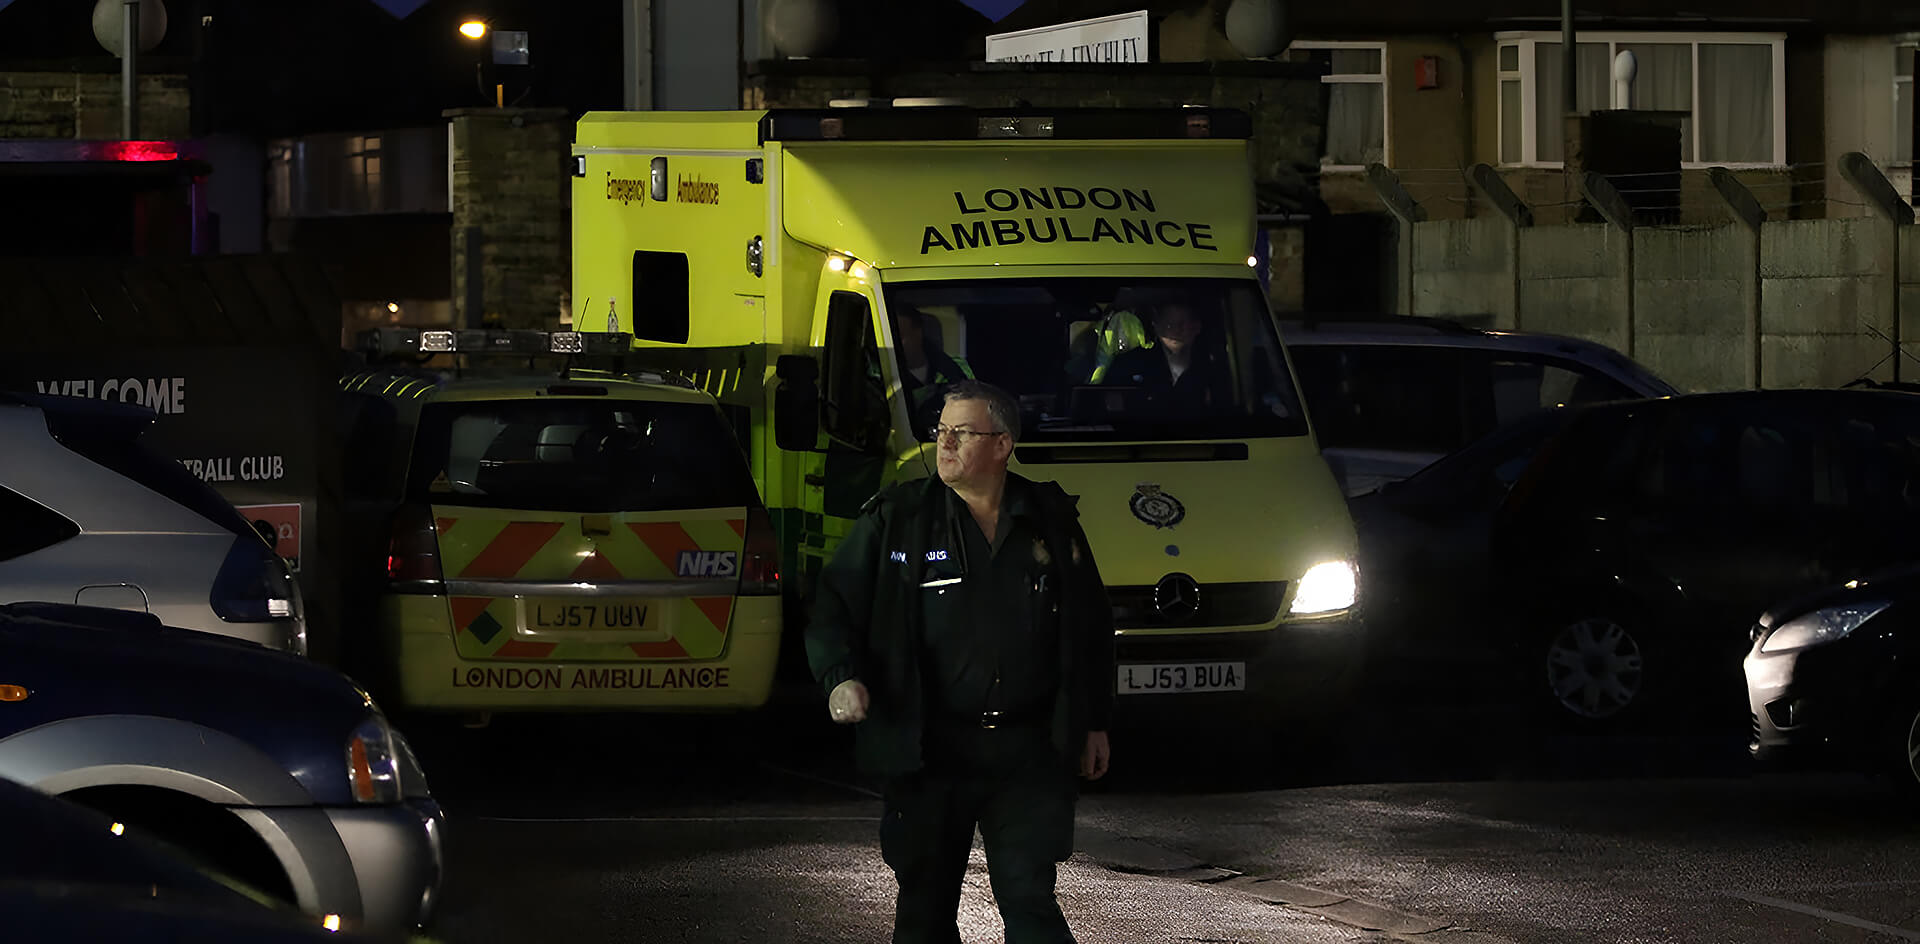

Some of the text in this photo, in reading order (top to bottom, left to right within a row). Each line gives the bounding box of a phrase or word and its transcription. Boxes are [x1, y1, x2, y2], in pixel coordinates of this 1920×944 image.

[606, 171, 720, 207] Emergency Ambulance
[954, 187, 1156, 214] LONDON
[920, 217, 1218, 254] AMBULANCE
[240, 455, 284, 481] CLUB
[678, 551, 737, 577] NHS
[537, 604, 597, 627] LJ57
[453, 667, 730, 689] LONDON AMBULANCE
[1128, 665, 1236, 689] LJ53 BUA
